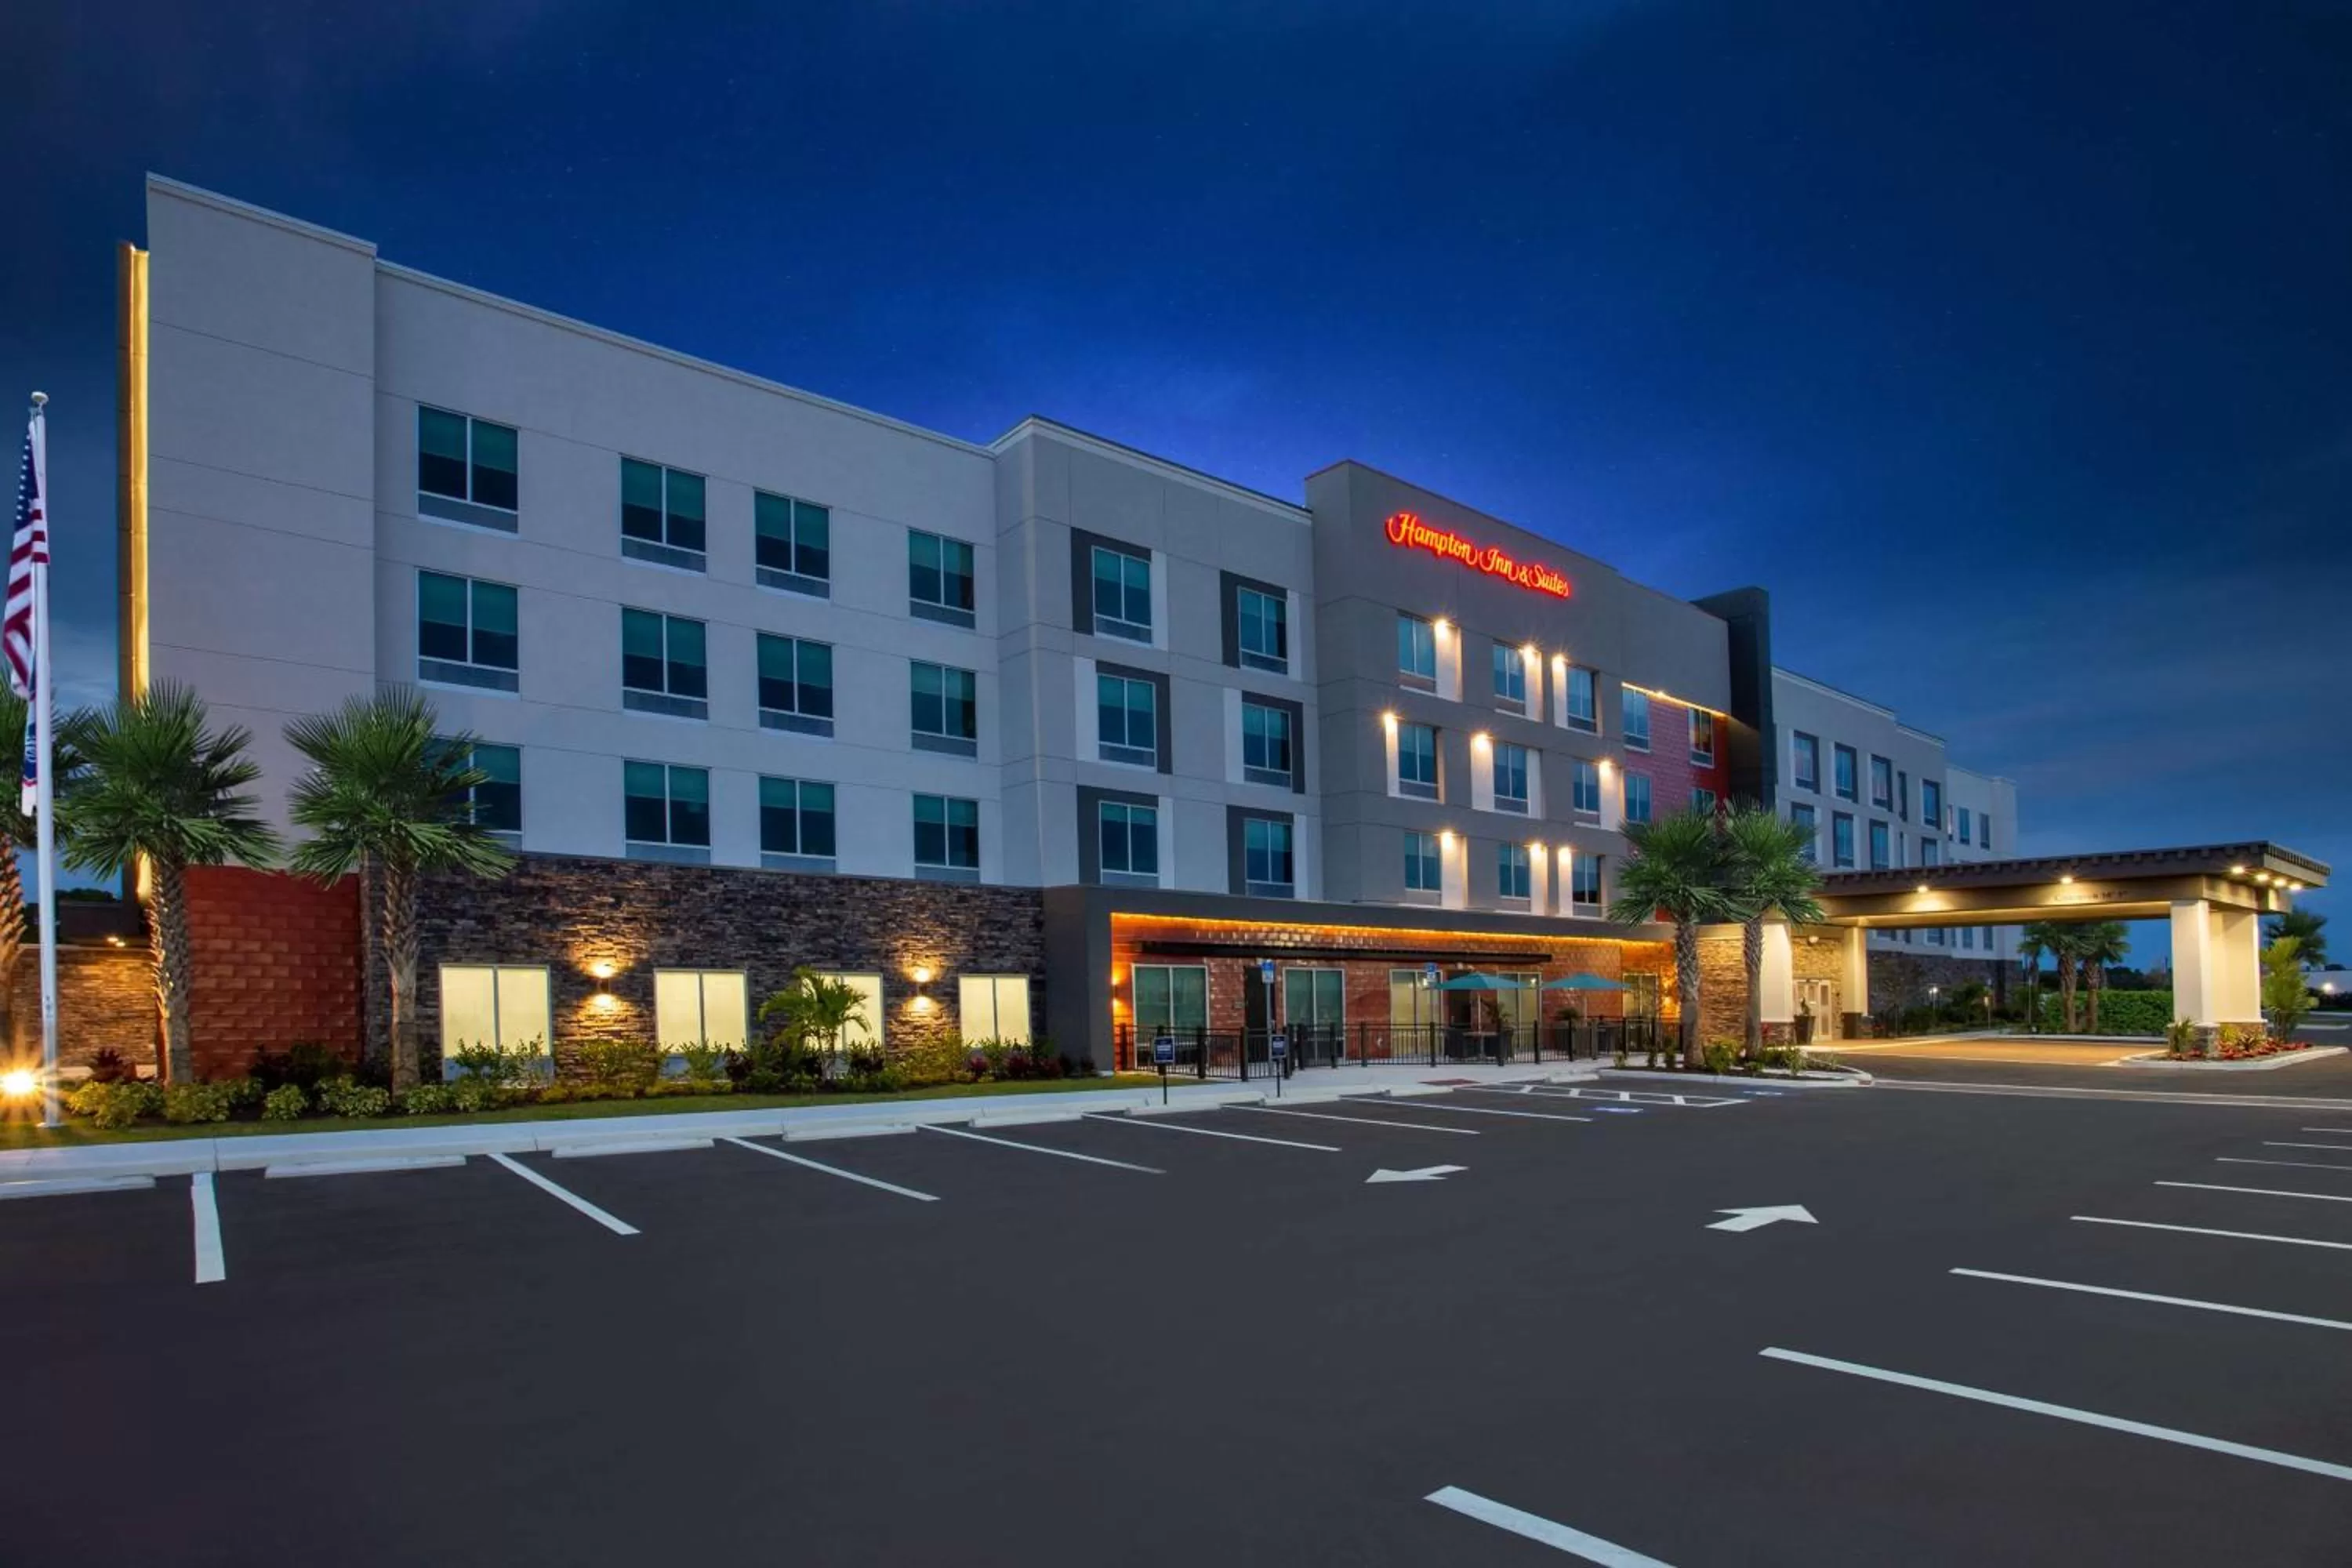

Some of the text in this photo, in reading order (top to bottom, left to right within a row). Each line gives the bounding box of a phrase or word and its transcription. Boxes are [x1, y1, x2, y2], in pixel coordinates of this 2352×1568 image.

[1386, 513, 1570, 597] Hampton Inn & Suites
